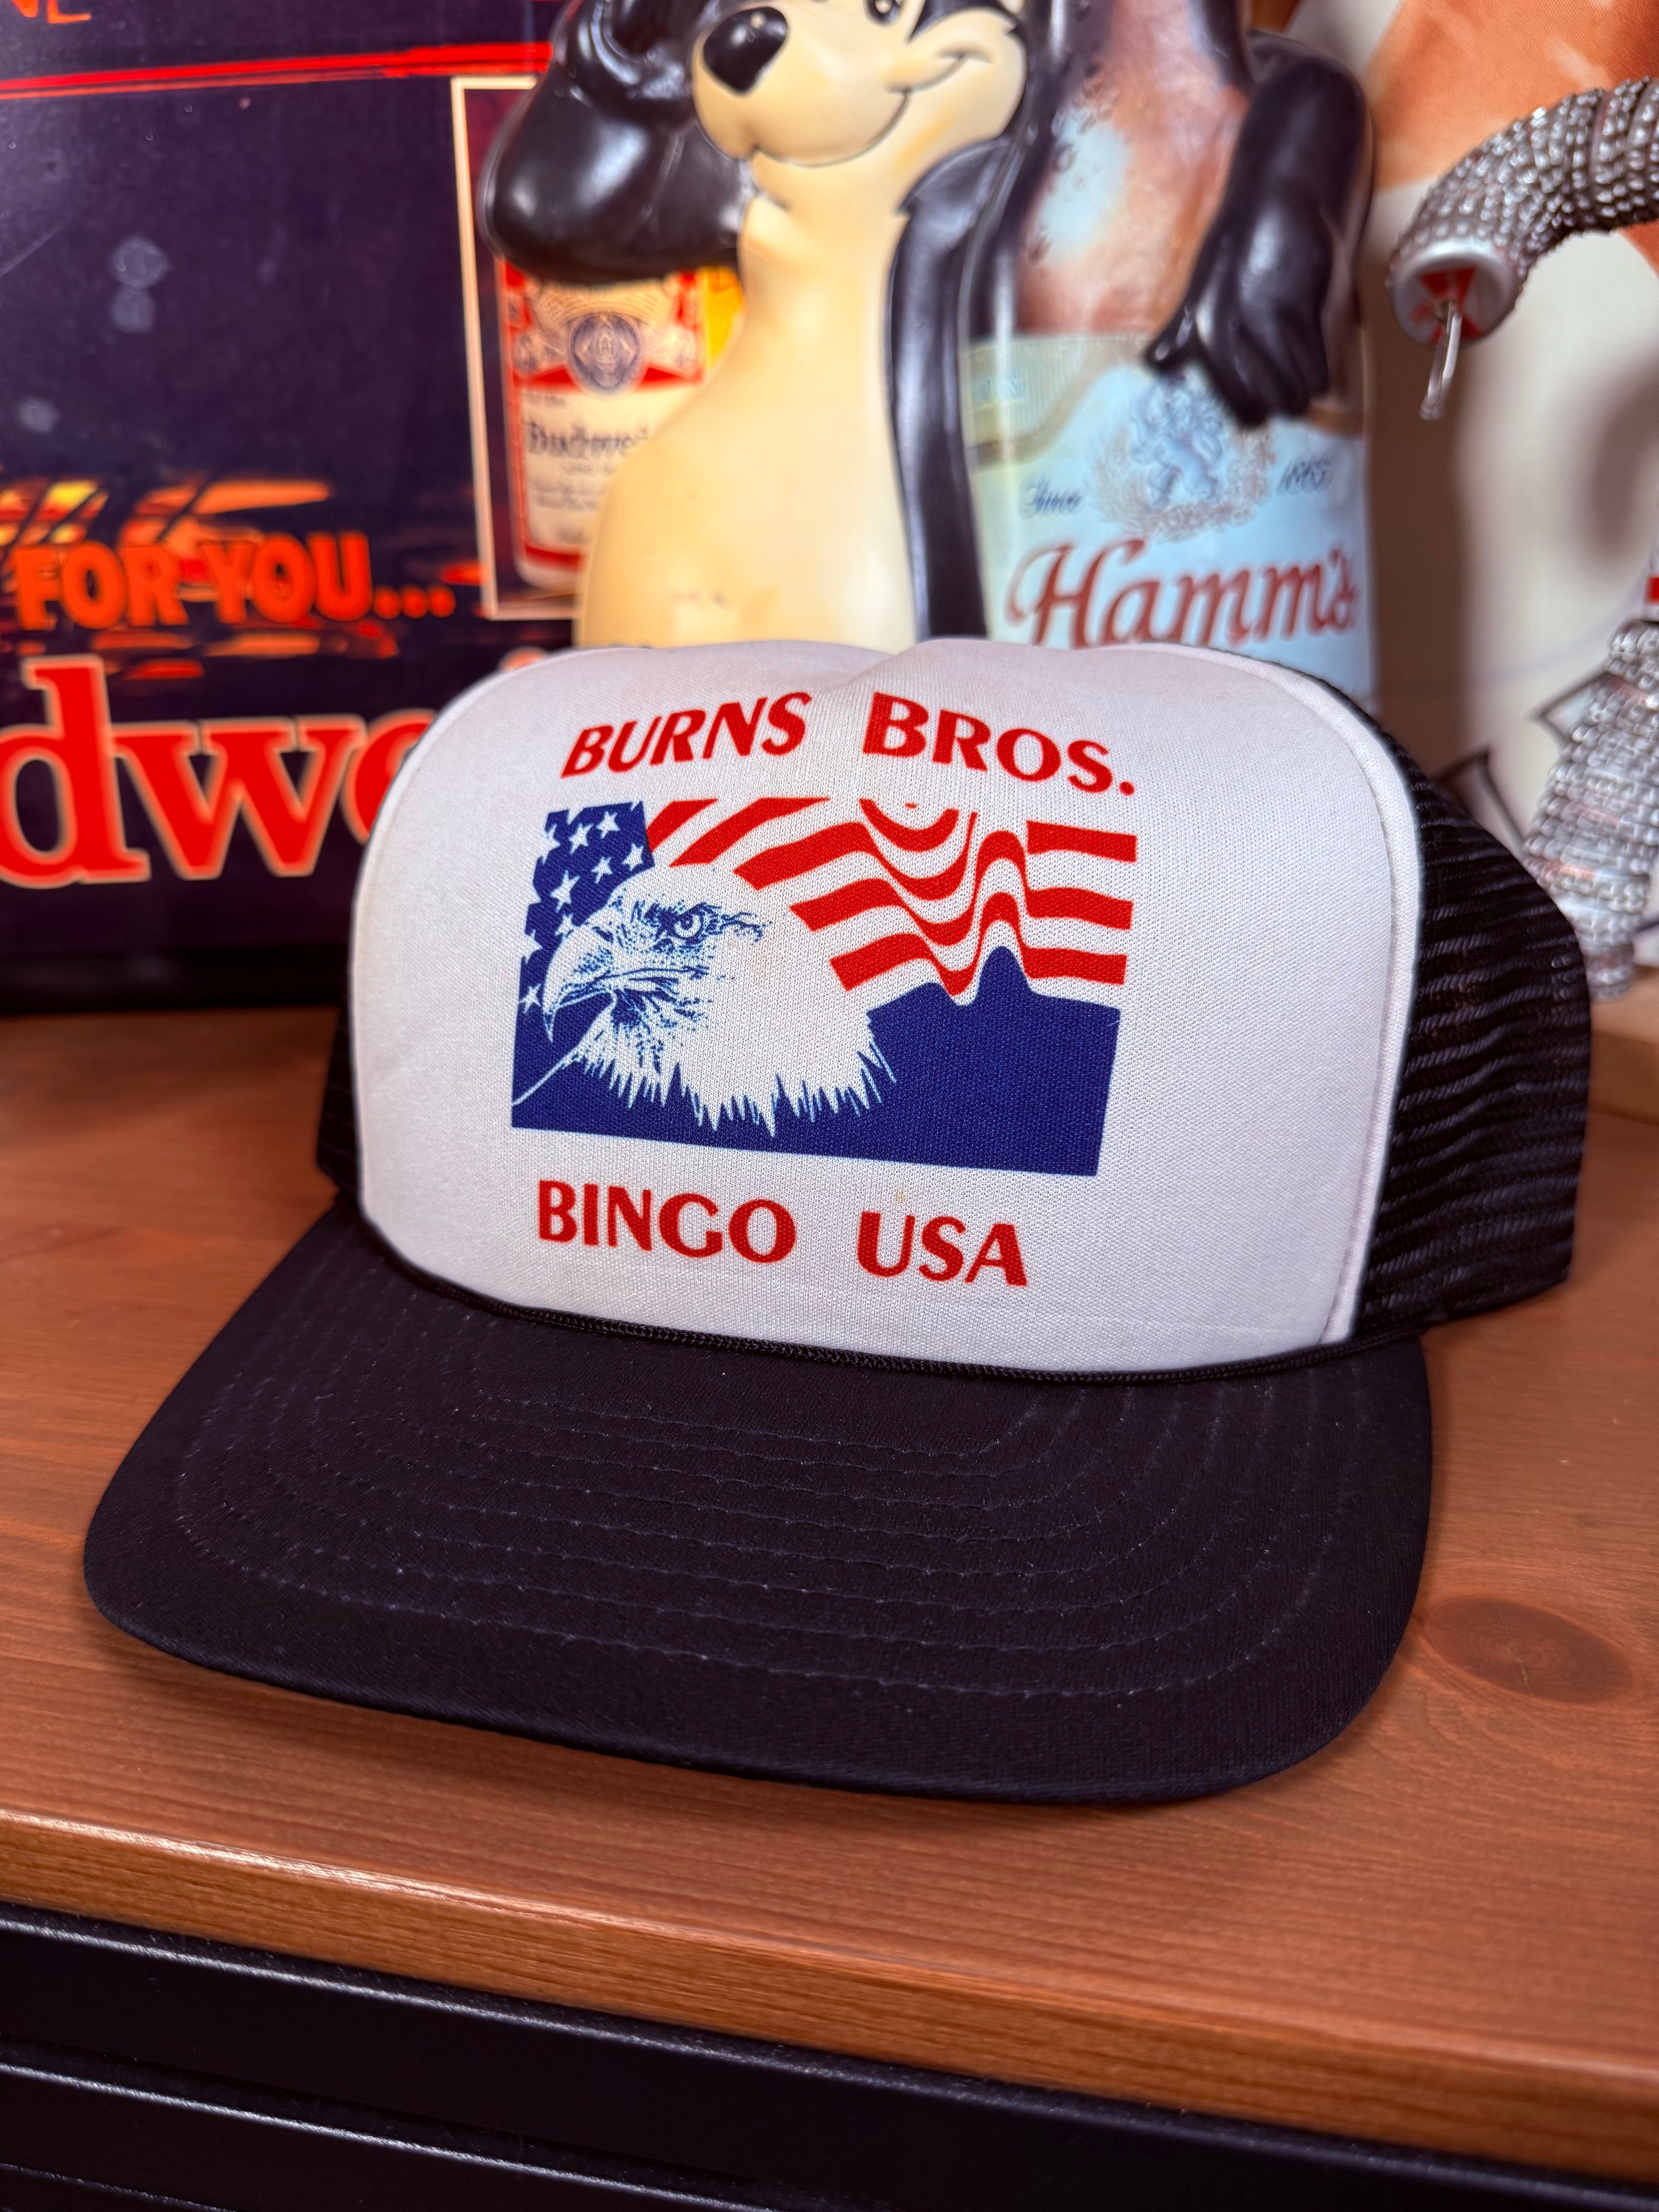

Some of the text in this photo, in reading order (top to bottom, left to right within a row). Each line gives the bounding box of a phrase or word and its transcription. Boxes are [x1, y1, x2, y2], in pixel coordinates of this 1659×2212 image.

[14, 540, 189, 631] FOR
[1004, 538, 1357, 649] Hamm's
[560, 691, 1135, 795] BURNS BROS.
[538, 1180, 1027, 1286] BINGO USA
